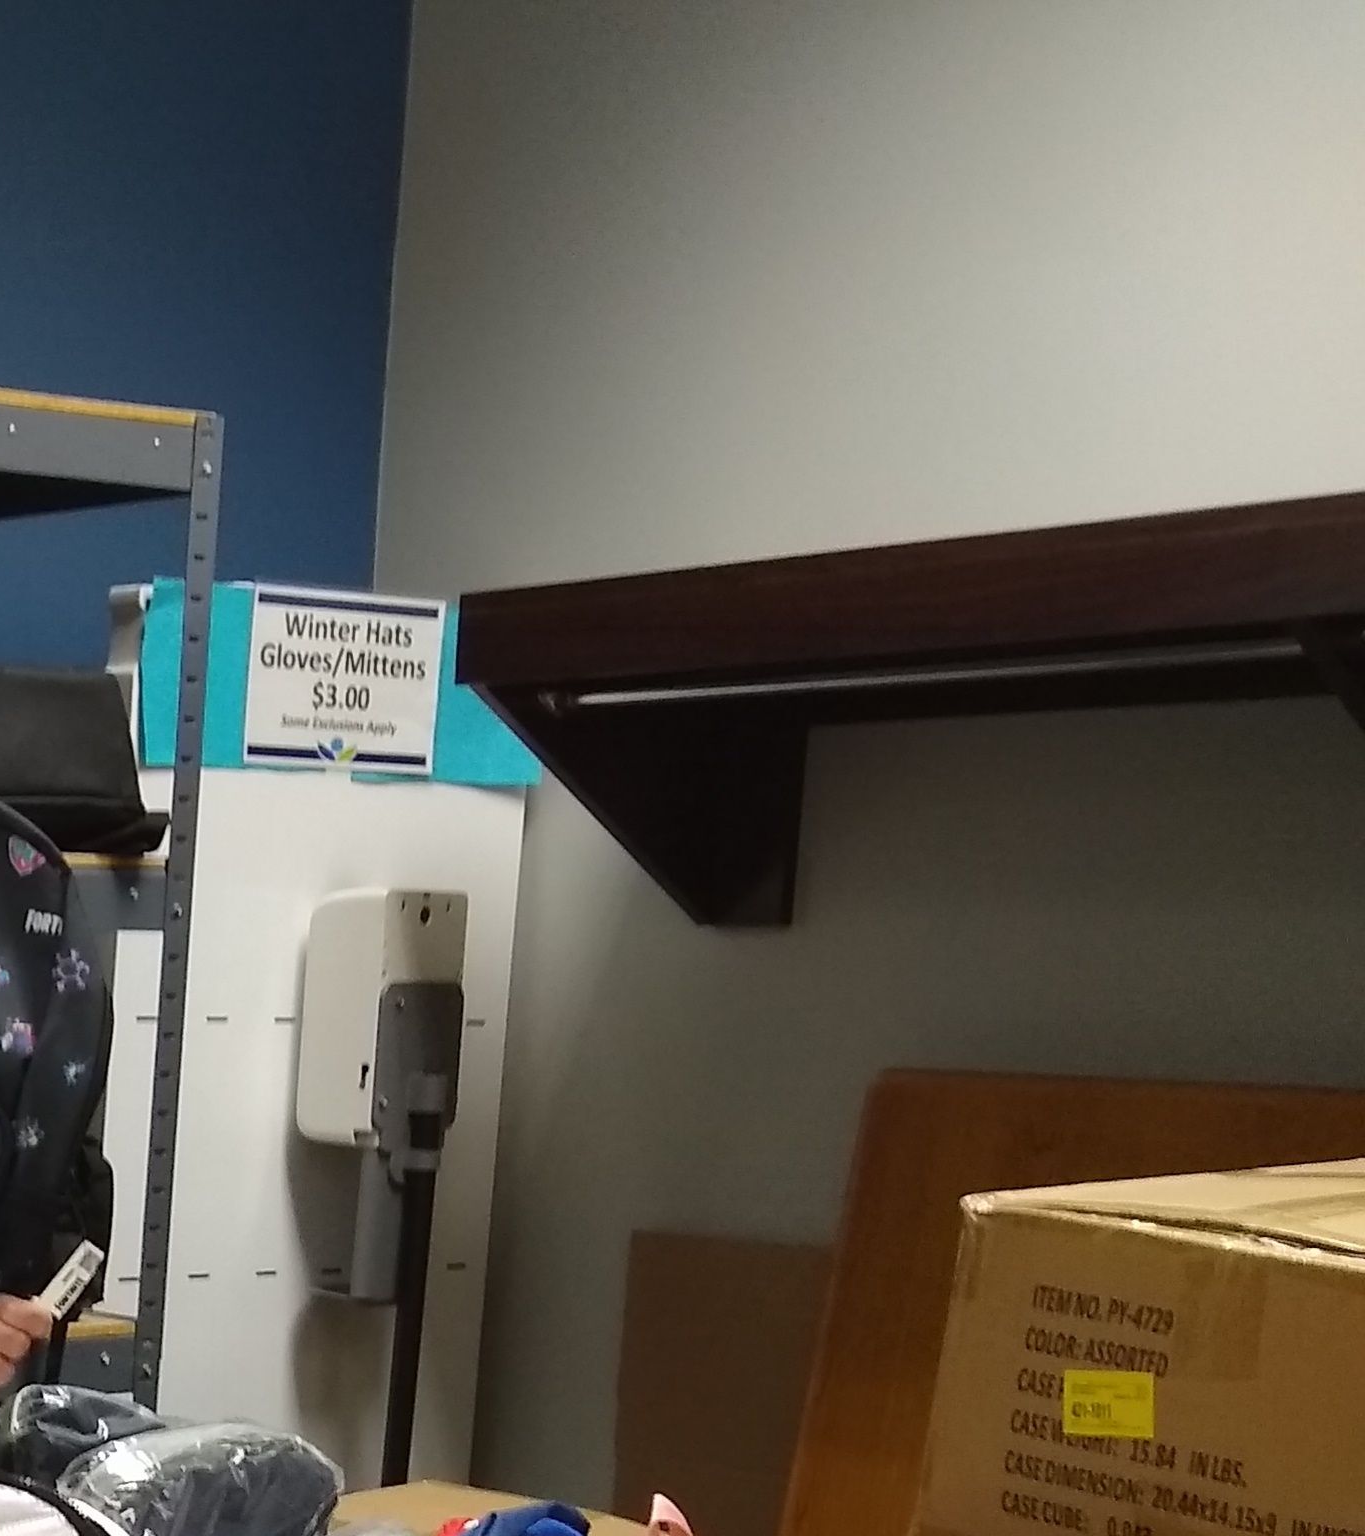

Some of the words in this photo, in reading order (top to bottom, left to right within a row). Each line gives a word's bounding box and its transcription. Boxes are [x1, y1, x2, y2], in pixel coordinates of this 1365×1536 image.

[285, 611, 360, 643] Winter
[366, 619, 413, 648] Hats
[260, 642, 426, 681] Gloves/Mittens
[312, 680, 370, 711] $3.00
[281, 714, 310, 729] Some
[312, 715, 364, 733] Exclusions
[366, 720, 397, 737] Apply
[26, 908, 63, 936] FORT
[1032, 1284, 1072, 1315] ITEM
[1072, 1293, 1102, 1321] NO.
[1108, 1298, 1175, 1335] PY-4729
[1025, 1325, 1081, 1359] COLOR:
[1084, 1338, 1169, 1377] ASSORTED
[1017, 1368, 1056, 1398] CASE
[1011, 1408, 1048, 1440] CASE
[1004, 1450, 1043, 1482] CASE
[1044, 1460, 1144, 1505] DIMENSION:
[1130, 1438, 1177, 1470] 15.84
[1189, 1451, 1210, 1478] IN
[1211, 1455, 1248, 1487] LBS.
[1001, 1490, 1039, 1522] CASE
[1042, 1500, 1087, 1533] CUBE:
